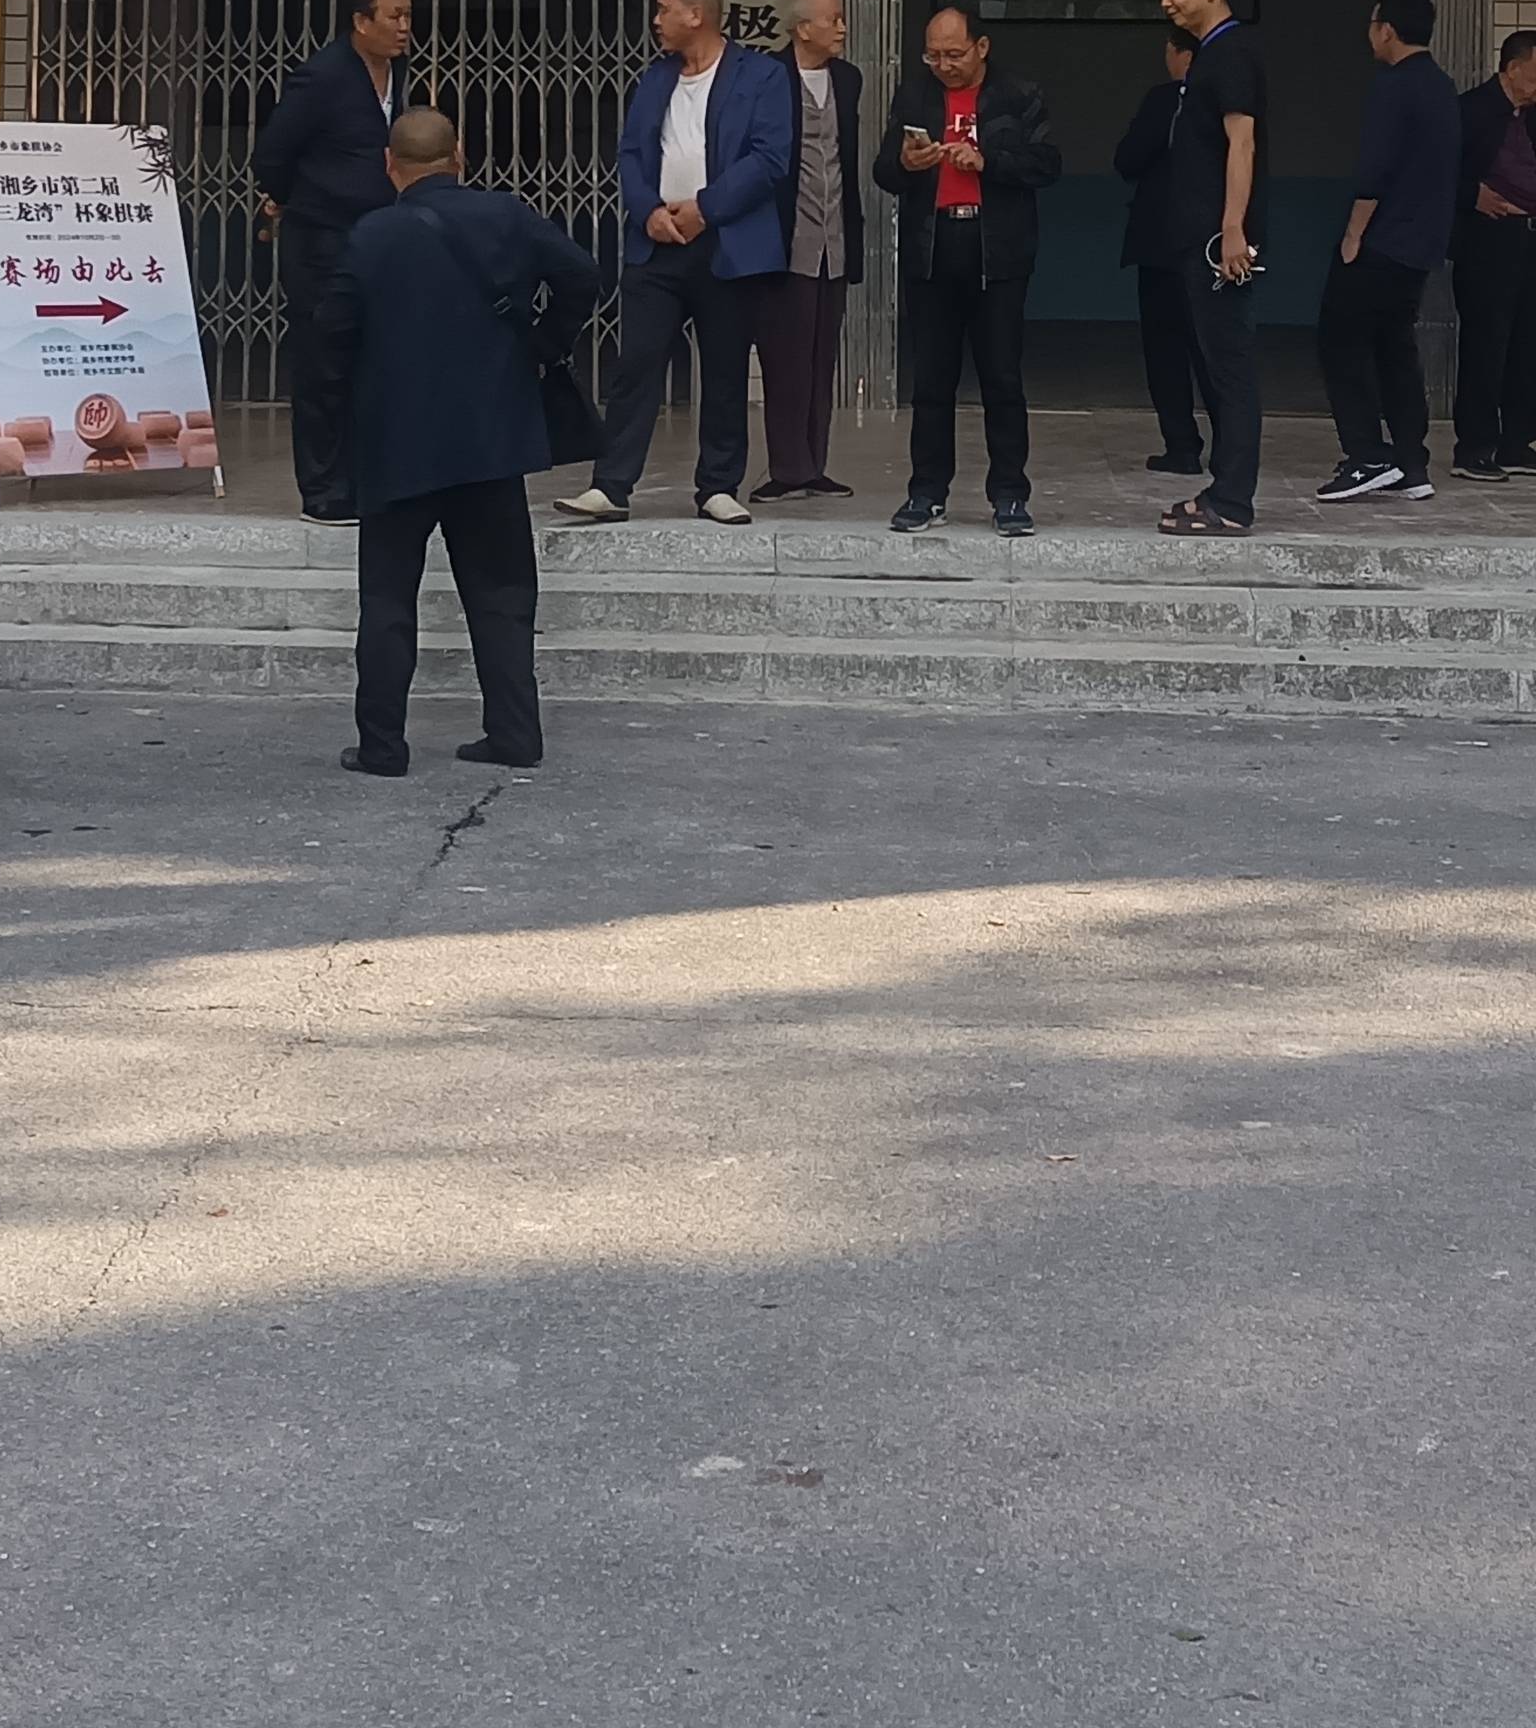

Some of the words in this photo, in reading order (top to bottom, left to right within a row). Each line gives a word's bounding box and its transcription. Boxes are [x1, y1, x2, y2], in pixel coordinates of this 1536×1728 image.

[0, 175, 121, 196] 湘乡市第二届
[0, 255, 166, 287] 赛场由此去
